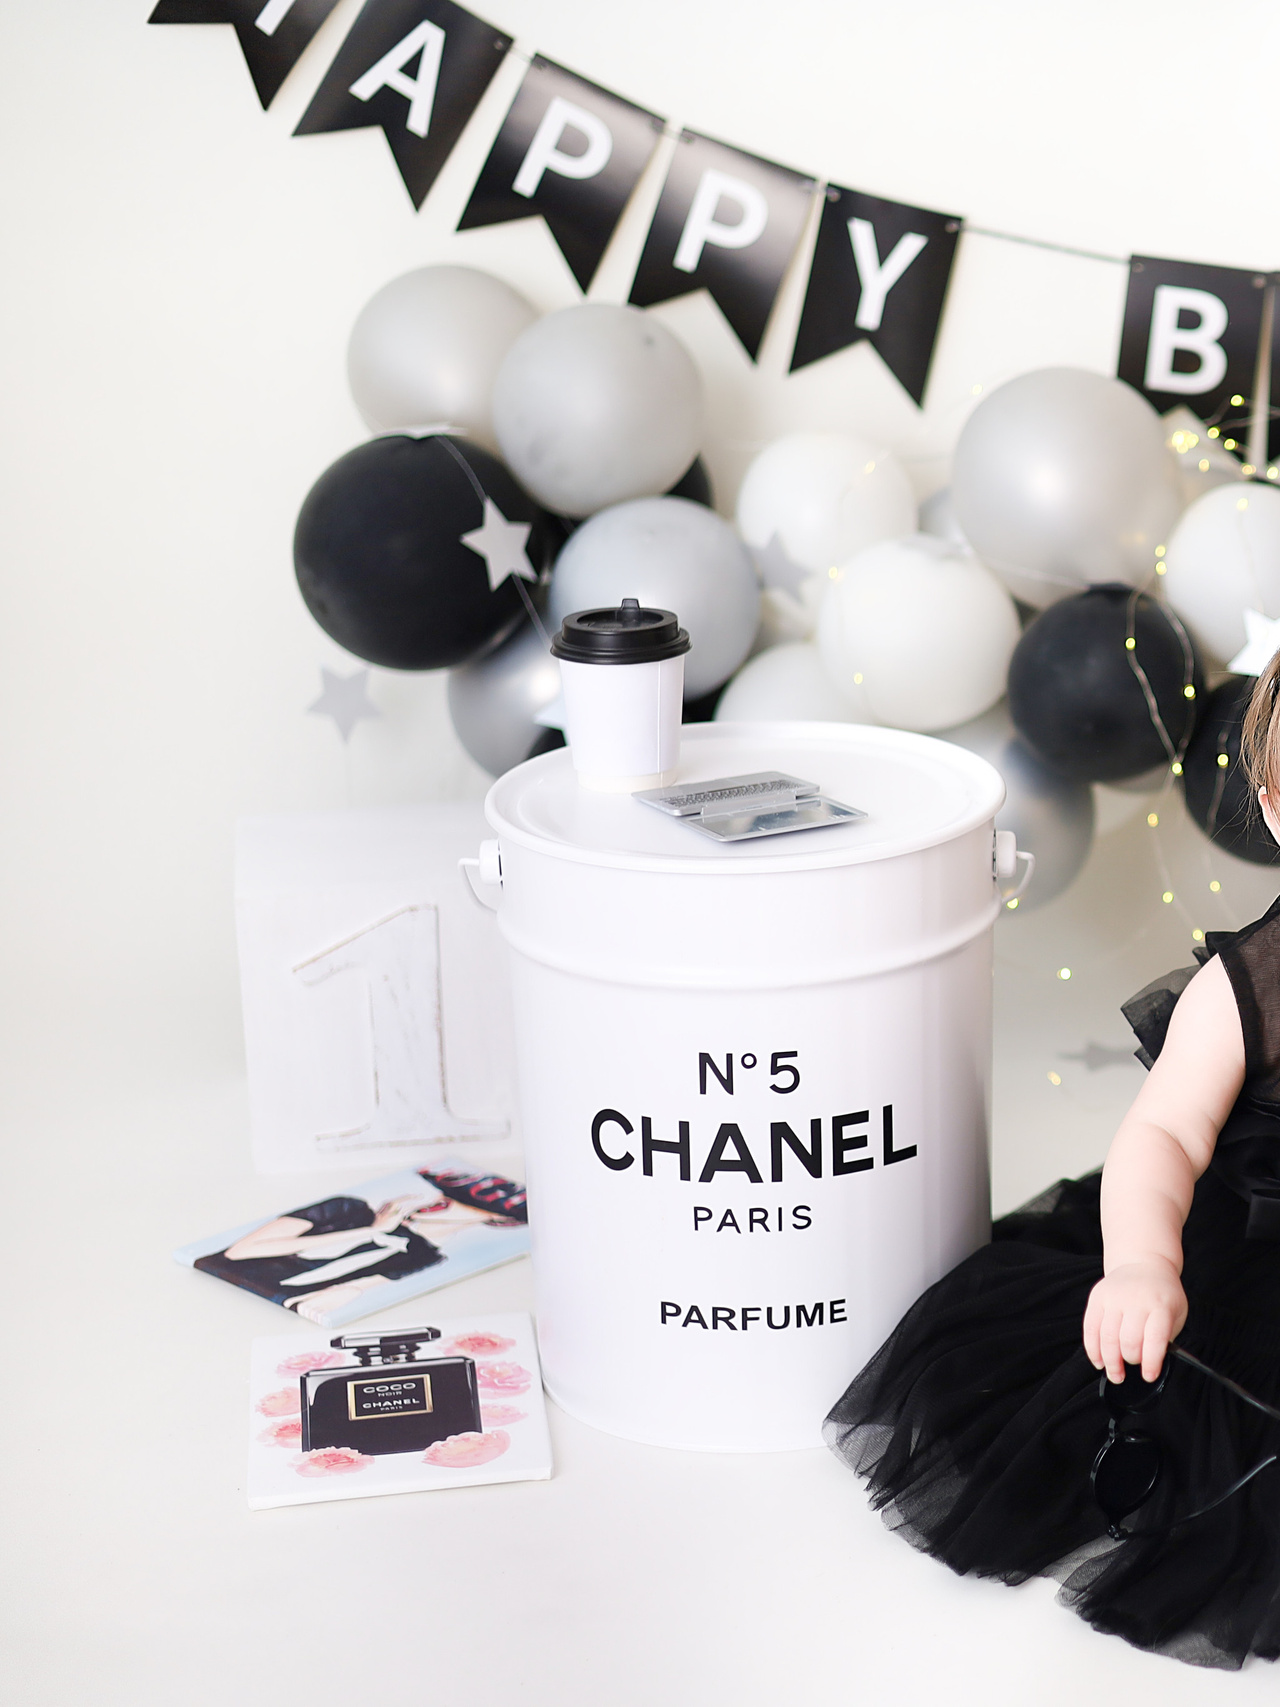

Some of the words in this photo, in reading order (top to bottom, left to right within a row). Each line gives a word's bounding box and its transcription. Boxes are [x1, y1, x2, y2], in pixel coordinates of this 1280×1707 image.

[254, 0, 928, 331] APPY
[292, 902, 511, 1152] 1
[591, 1104, 918, 1184] CHANEL
[693, 1205, 813, 1234] PARIS
[660, 1298, 848, 1331] PARFUME
[362, 1382, 416, 1394] COCO
[362, 1398, 420, 1409] CHANEL
